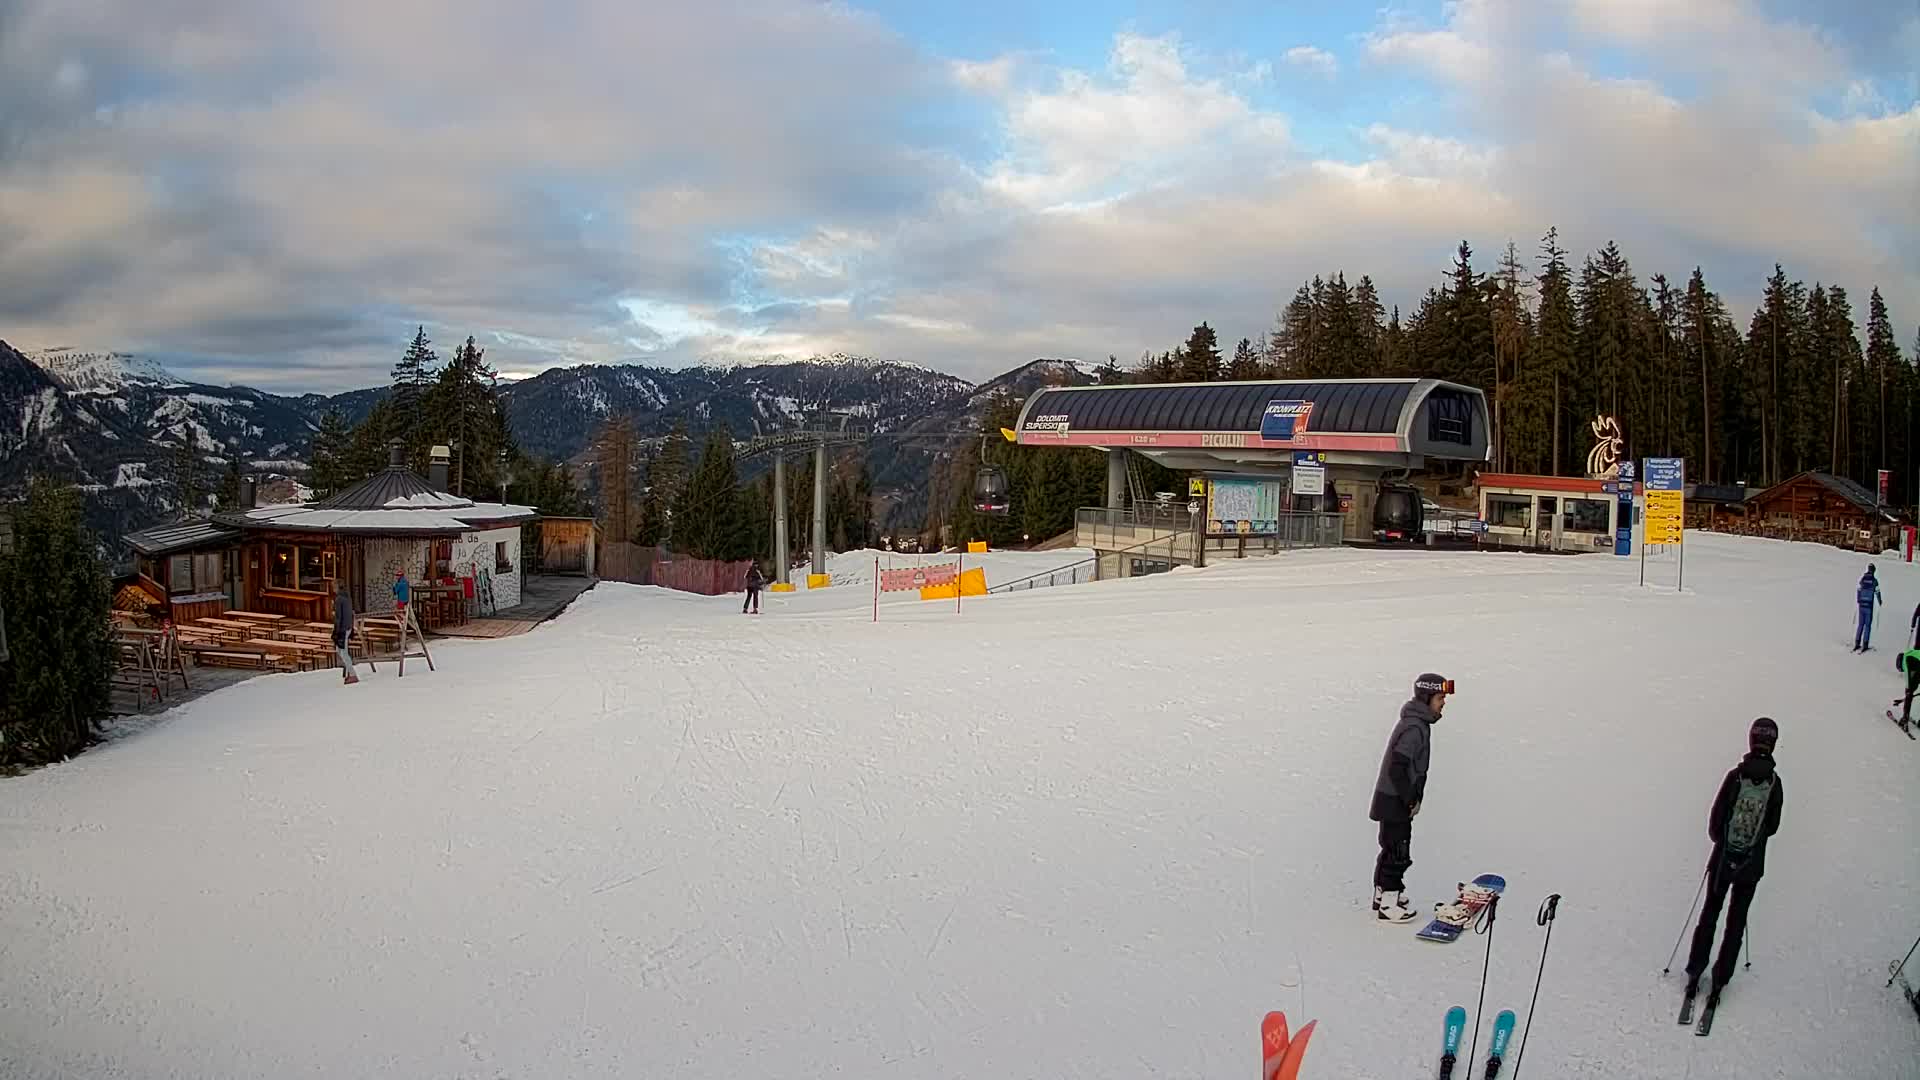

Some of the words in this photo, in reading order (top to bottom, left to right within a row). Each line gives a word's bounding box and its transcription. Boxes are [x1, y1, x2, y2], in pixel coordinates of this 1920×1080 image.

[1036, 414, 1069, 422] DOLOMITI
[1025, 422, 1059, 430] SUPERSKI
[1202, 434, 1245, 447] PICULIN
[1447, 1025, 1457, 1047] HEAD
[1494, 1029, 1505, 1050] HEAD
